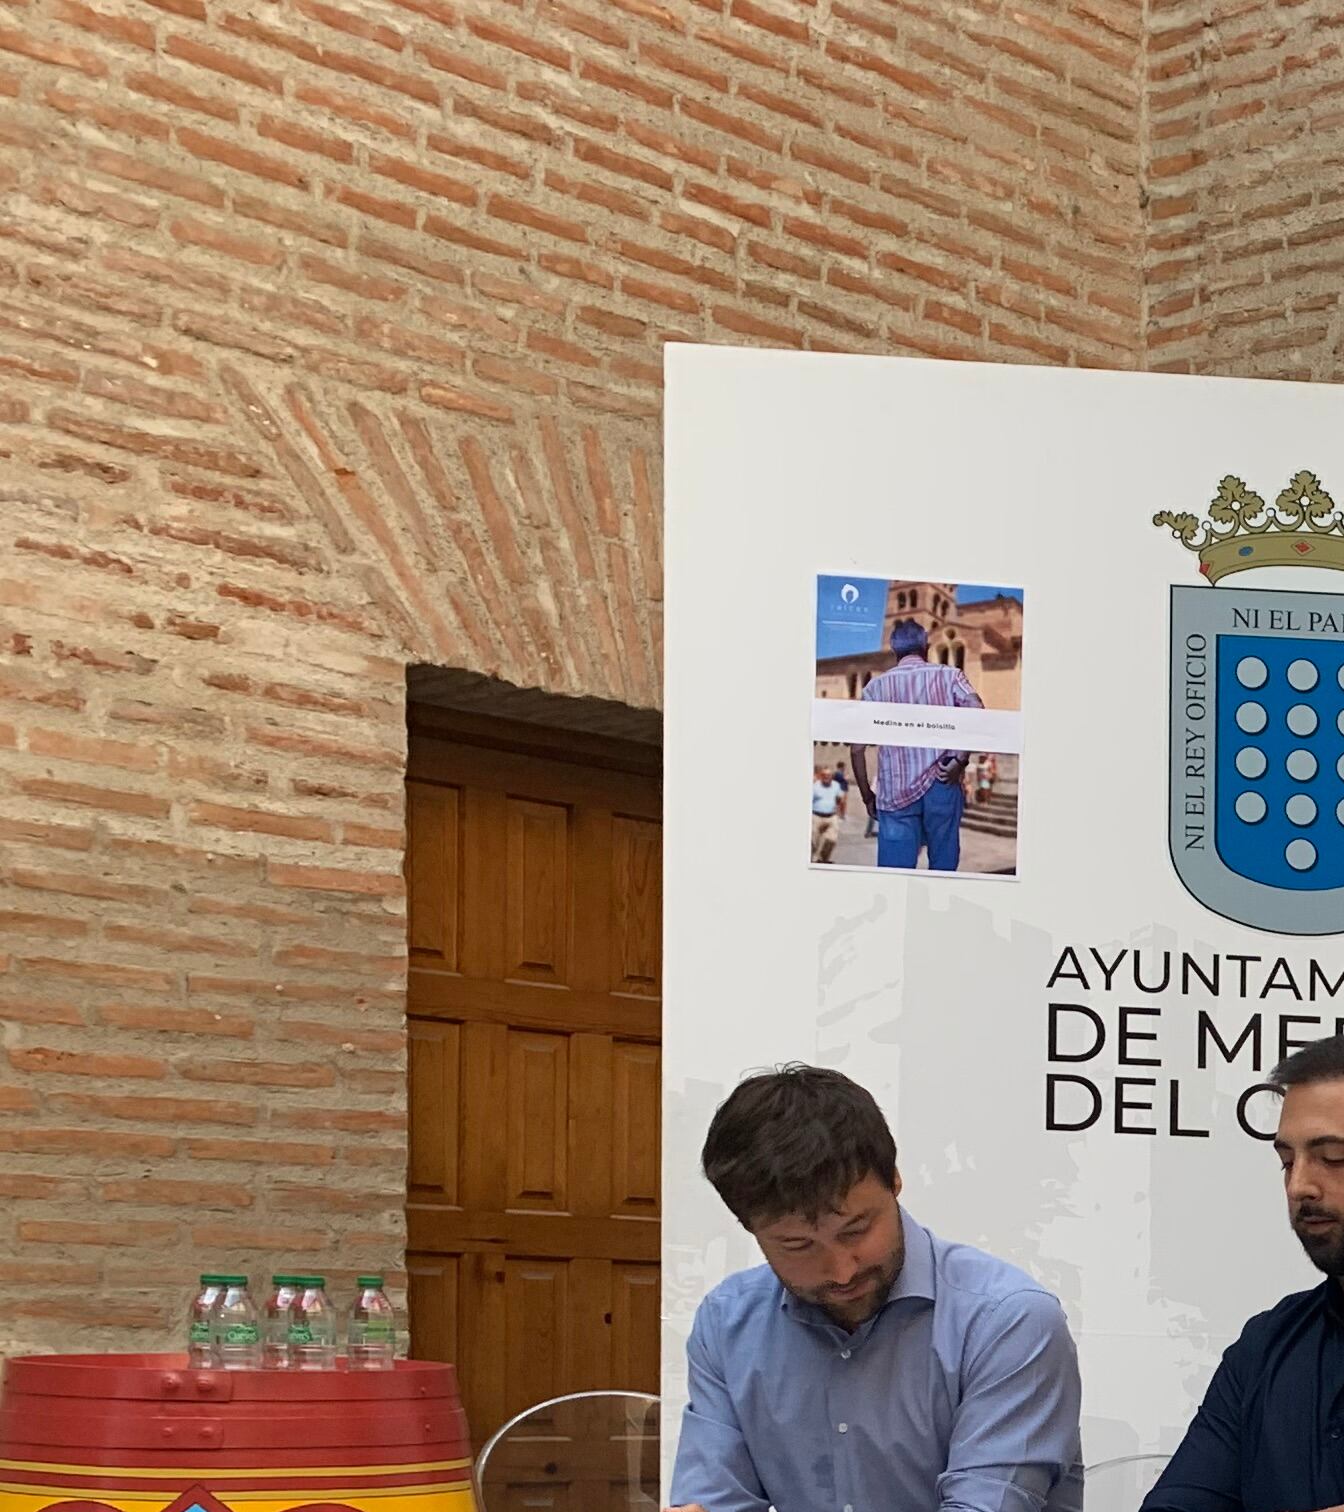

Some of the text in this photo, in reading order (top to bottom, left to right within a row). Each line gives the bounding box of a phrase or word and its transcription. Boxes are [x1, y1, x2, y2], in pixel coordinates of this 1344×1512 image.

[1231, 607, 1259, 629] NI
[1269, 610, 1300, 631] EL
[1185, 634, 1207, 851] NI EL REY OFICIO
[1047, 1003, 1162, 1066] DE
[1046, 1073, 1209, 1138] DEL
